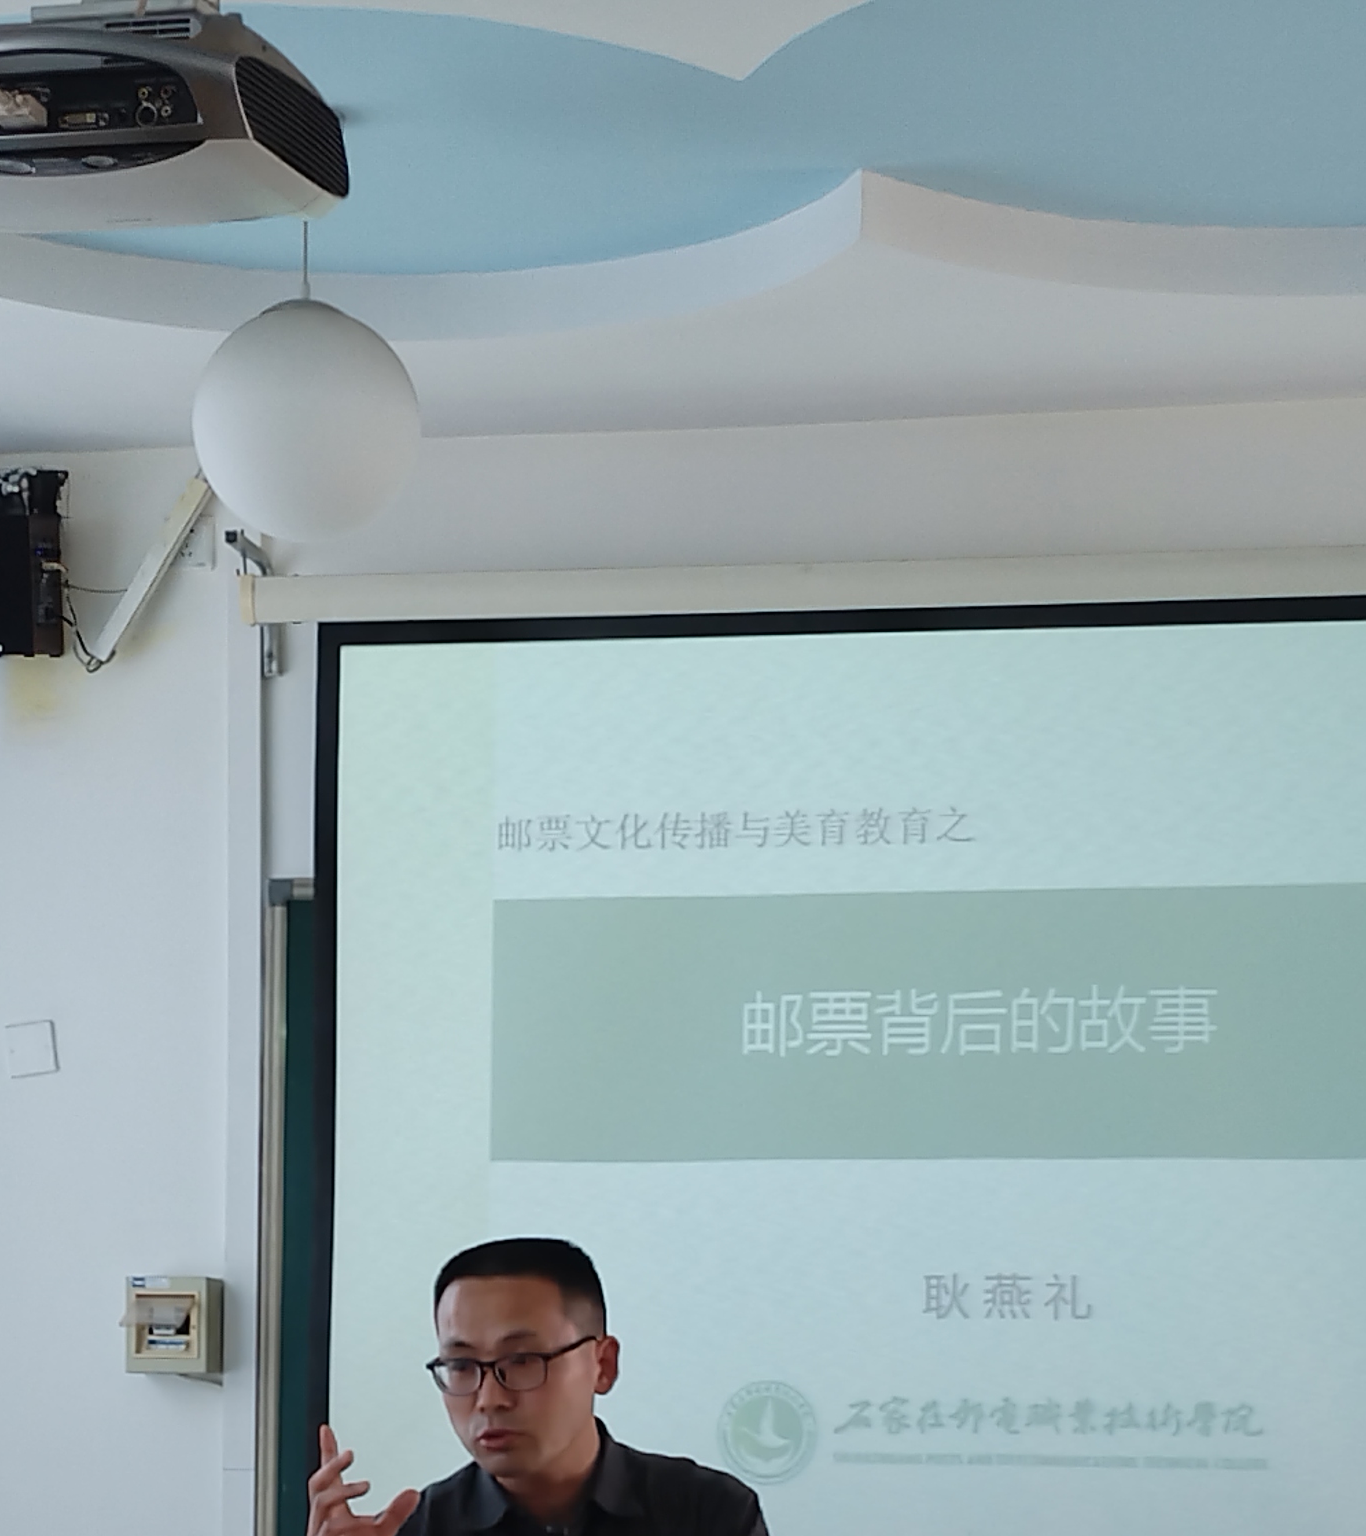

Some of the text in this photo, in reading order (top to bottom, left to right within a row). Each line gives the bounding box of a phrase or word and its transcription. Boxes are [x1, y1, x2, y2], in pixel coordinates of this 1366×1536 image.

[497, 806, 977, 852] 邮票文化传播与美育教育之
[742, 984, 1219, 1058] 邮票背后的故事
[921, 1273, 1094, 1321] 耿燕礼
